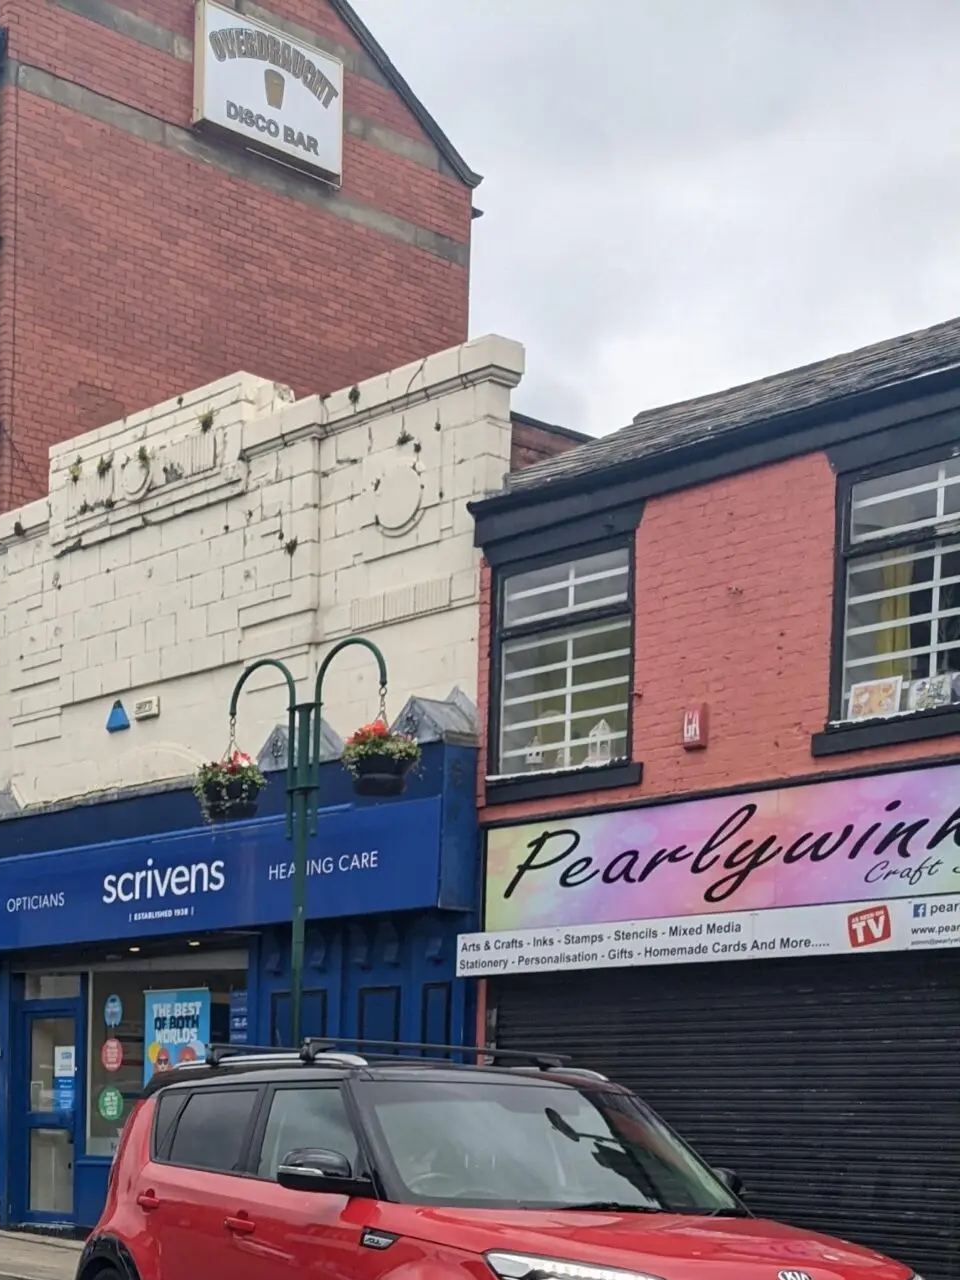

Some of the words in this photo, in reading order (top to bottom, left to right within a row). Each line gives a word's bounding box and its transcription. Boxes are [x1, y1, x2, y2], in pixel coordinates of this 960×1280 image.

[209, 28, 339, 109] OVERDRAUGHT
[226, 100, 280, 138] DISCO
[283, 125, 320, 156] BAR
[268, 856, 334, 881] HEAING
[339, 850, 379, 872] CARE
[864, 856, 944, 885] Craft
[102, 858, 226, 904] scrivens
[6, 892, 65, 912] OPTICIANS
[134, 910, 173, 921] ESTABLISHED
[930, 903, 960, 916] pear
[461, 941, 481, 952] Arts
[484, 940, 491, 950] &
[494, 938, 524, 950] Crafts
[533, 936, 554, 947] Inks
[564, 933, 604, 946] Stamps
[614, 929, 658, 941] Stencils
[669, 924, 703, 937] Mixed
[706, 921, 742, 935] Media
[852, 915, 885, 944] TV
[911, 925, 960, 935] www.pear
[459, 957, 509, 971] Stationery
[518, 952, 598, 966] Personalisation
[608, 948, 633, 959] Gifts
[644, 943, 708, 957] Homemade
[712, 941, 747, 953] Cards
[750, 938, 776, 951] And
[780, 937, 830, 950] More.....
[152, 1003, 171, 1016] THE
[173, 1001, 202, 1015] BEST
[154, 1017, 167, 1030] OF
[169, 1015, 200, 1029] BOTH
[155, 1028, 198, 1044] WORLDS
